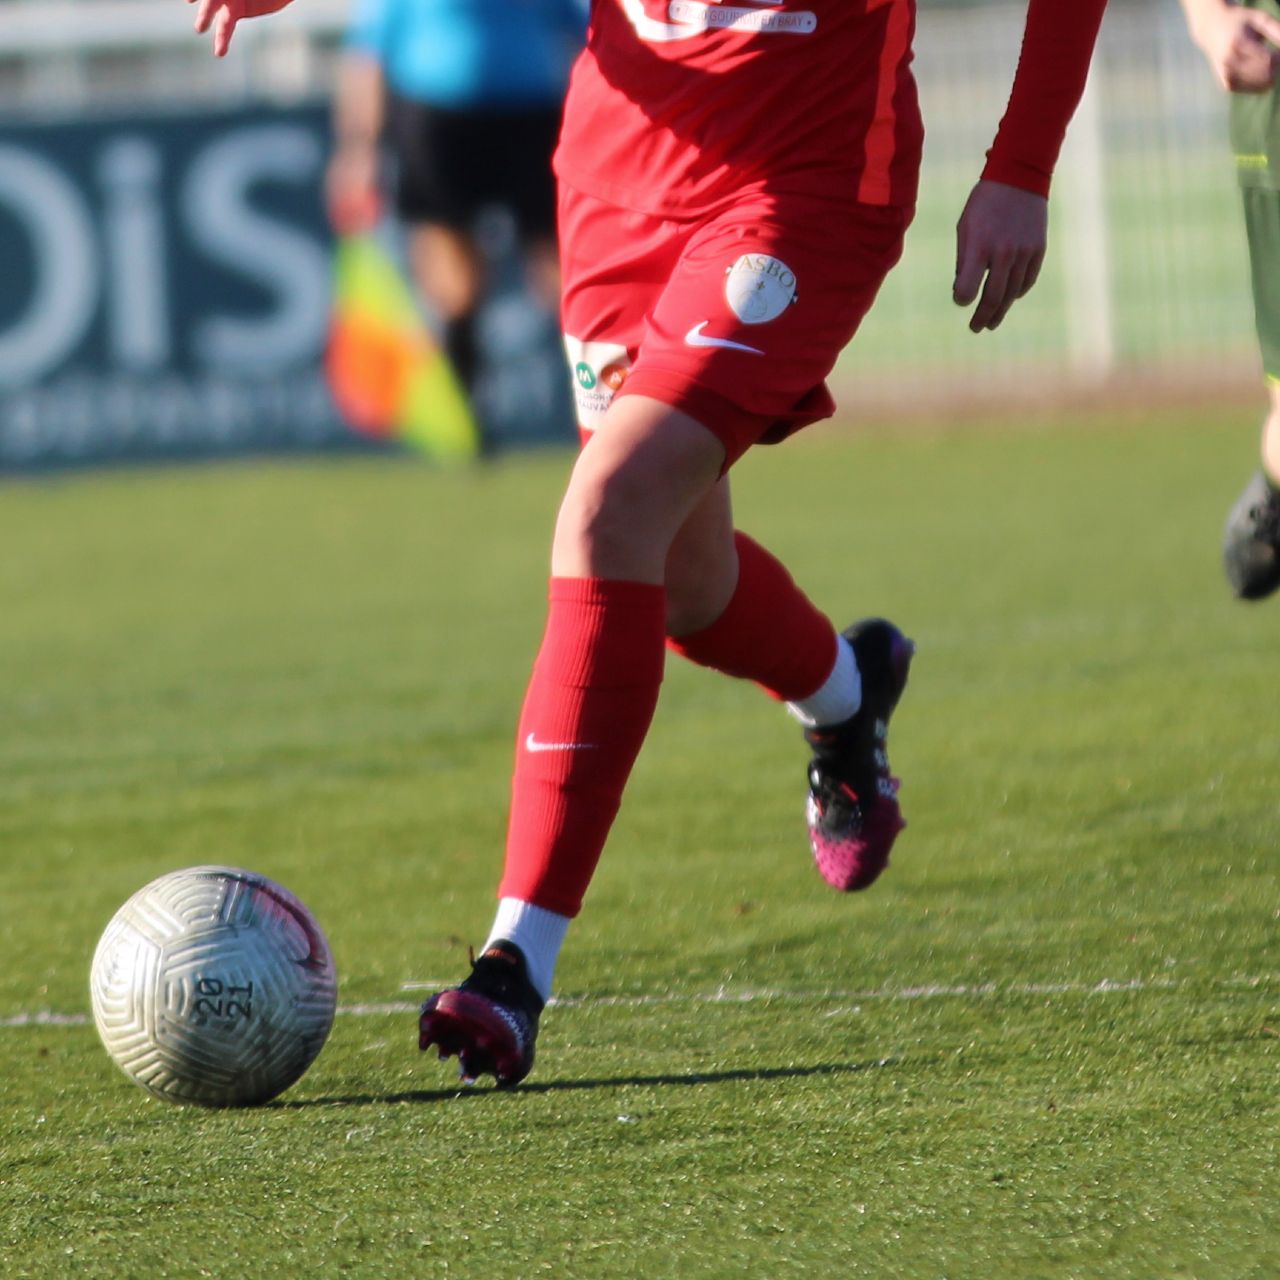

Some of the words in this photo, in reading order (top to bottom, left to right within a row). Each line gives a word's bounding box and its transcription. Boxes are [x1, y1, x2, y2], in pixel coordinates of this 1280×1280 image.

[710, 10, 759, 25] GOURNAY
[761, 14, 777, 26] EN
[778, 14, 804, 26] BRAY
[741, 255, 795, 289] ASBO
[194, 977, 224, 1018] 20
[225, 981, 254, 1021] 21
